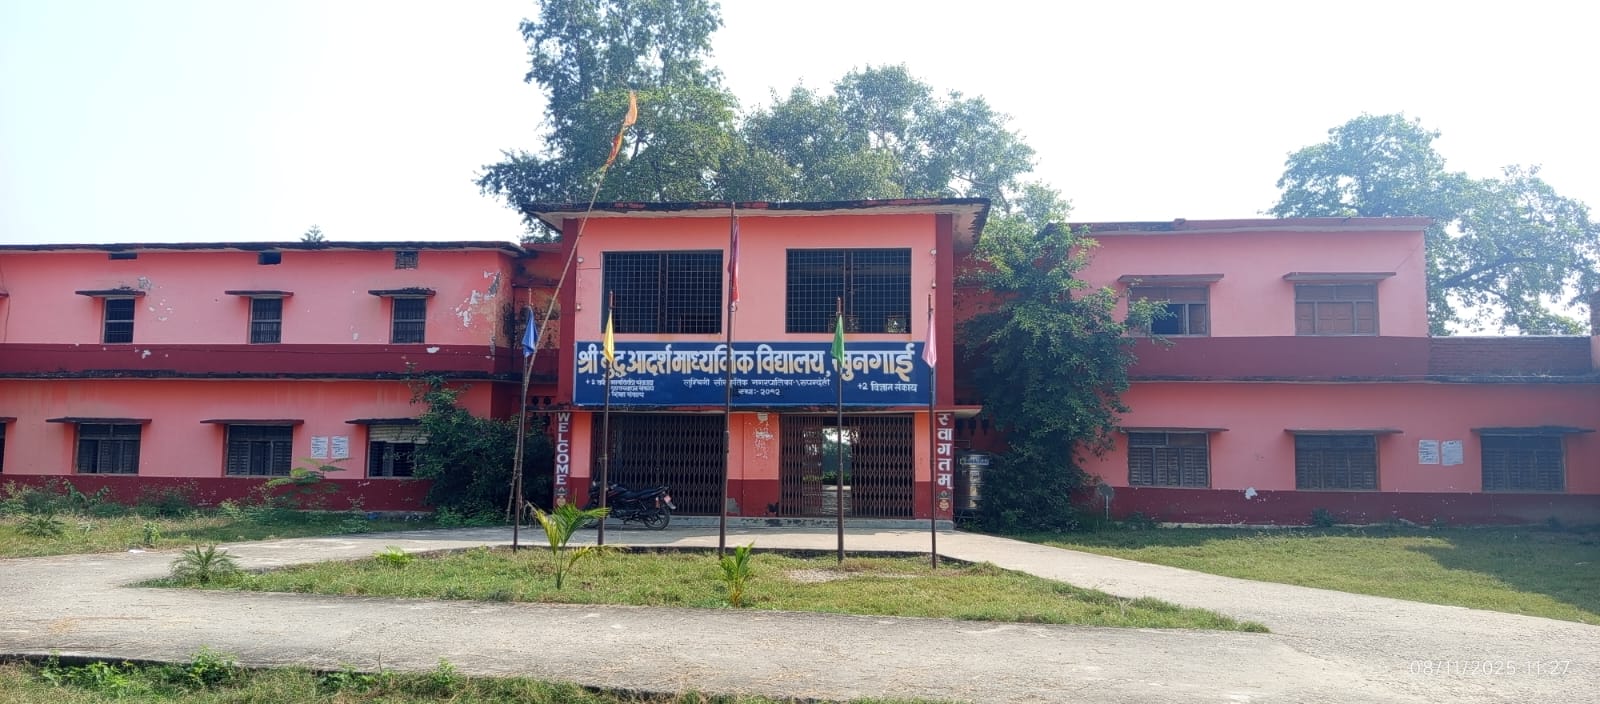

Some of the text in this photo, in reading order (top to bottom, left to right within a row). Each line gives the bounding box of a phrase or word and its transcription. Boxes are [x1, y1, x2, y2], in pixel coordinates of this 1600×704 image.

[578, 344, 598, 374] श्री
[627, 344, 671, 376] आदर्श
[894, 381, 918, 393] संकाय
[556, 412, 571, 485] WELCOME
